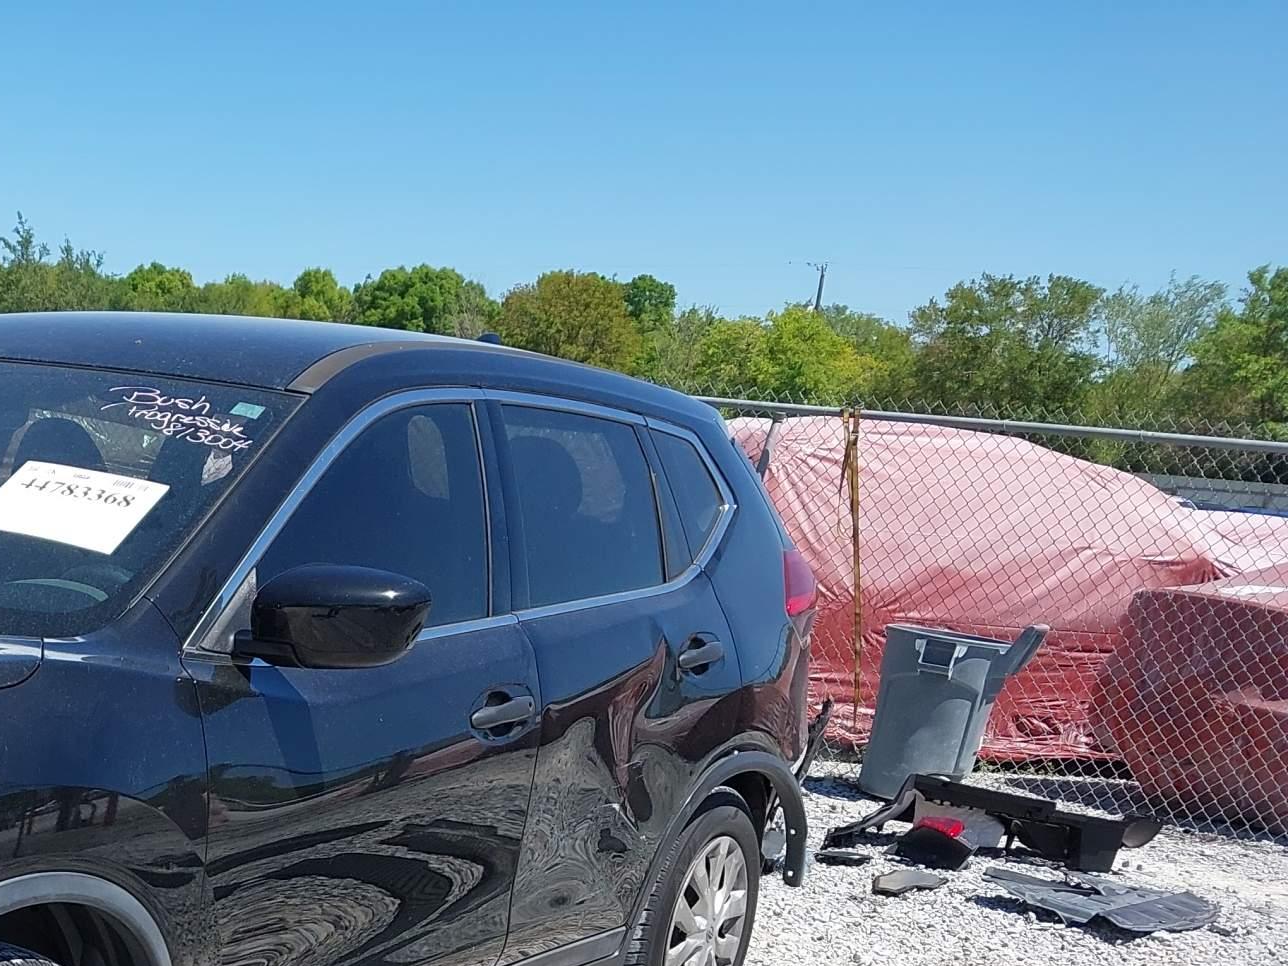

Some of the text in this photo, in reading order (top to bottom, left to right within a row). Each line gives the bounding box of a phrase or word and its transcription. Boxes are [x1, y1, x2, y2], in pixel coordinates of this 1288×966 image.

[109, 386, 210, 414] Bush
[162, 422, 253, 451] 813004
[20, 478, 136, 507] 44783368
